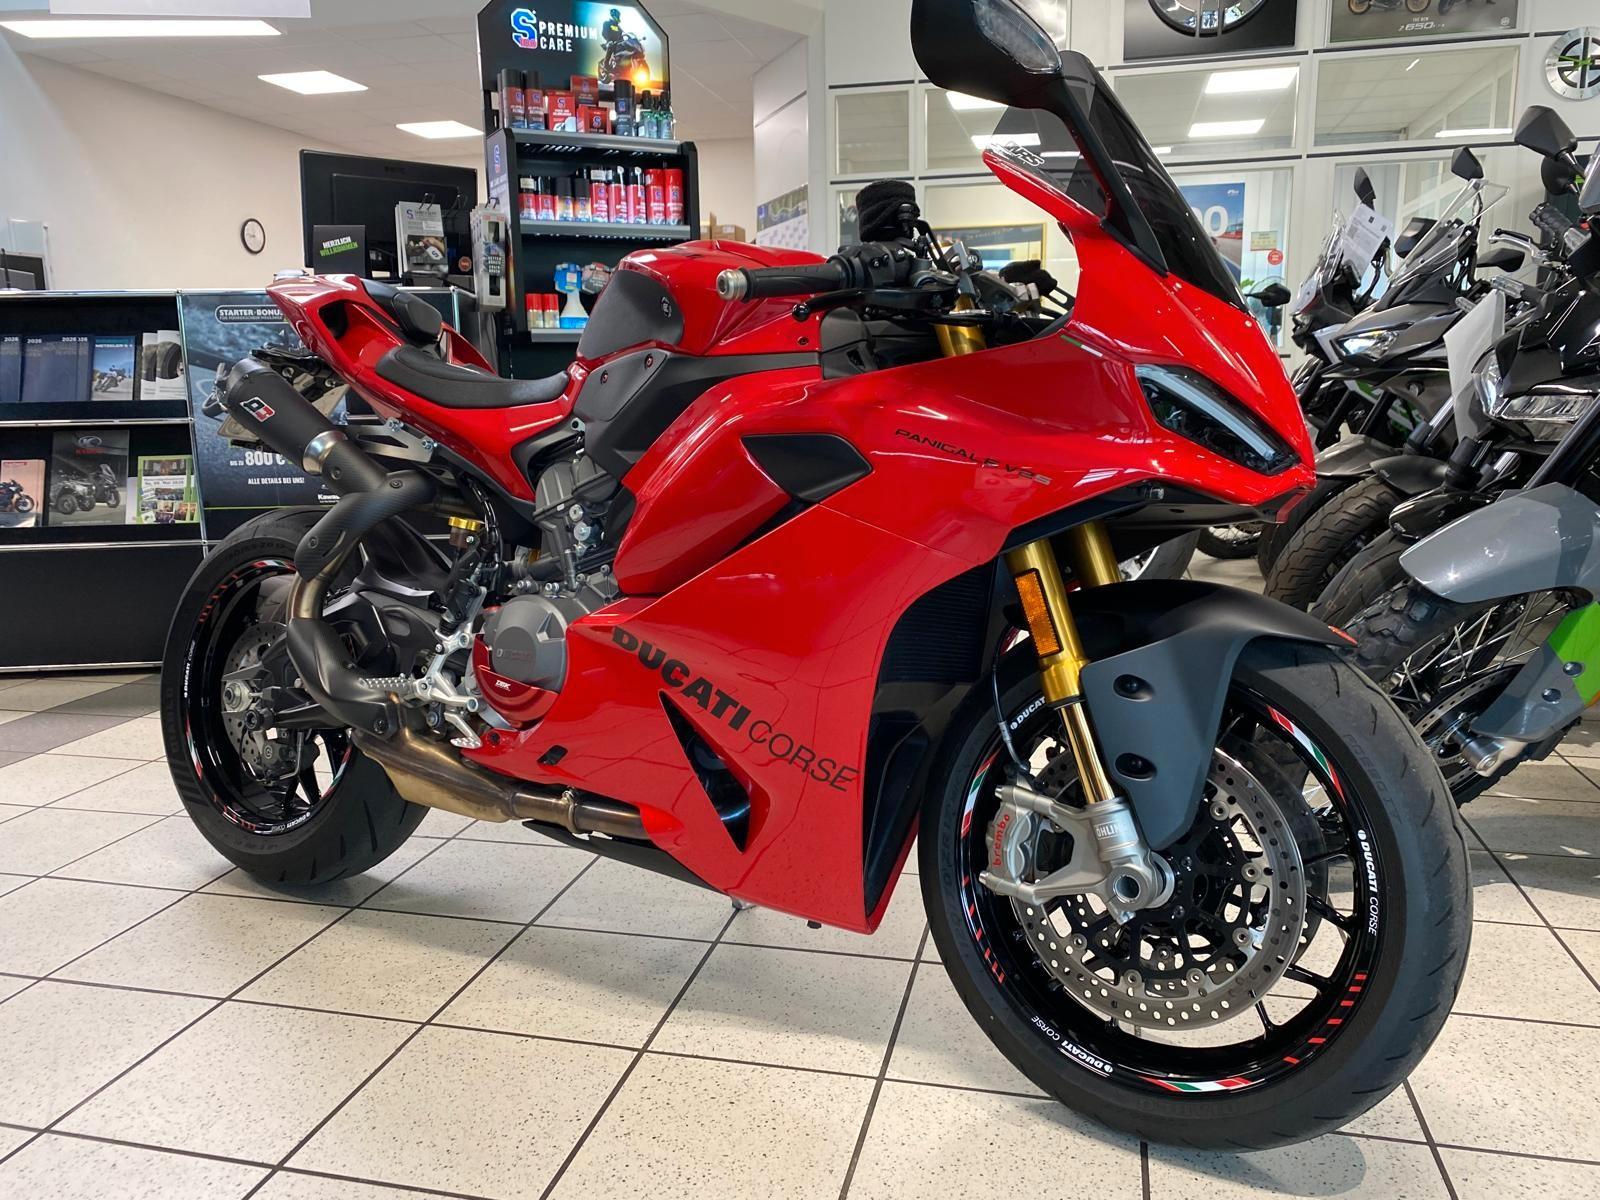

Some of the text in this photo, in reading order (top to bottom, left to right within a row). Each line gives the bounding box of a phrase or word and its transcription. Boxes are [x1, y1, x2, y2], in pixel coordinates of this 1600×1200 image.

[539, 21, 597, 40] PREMIUM
[540, 37, 573, 52] CARE
[219, 309, 284, 317] STARTER-BONU
[245, 451, 273, 466] 800
[261, 477, 282, 485] DETAILS
[282, 477, 292, 485] BEI
[612, 624, 860, 792] DUCATI CORSE
[992, 814, 1009, 867] brembo
[1361, 841, 1379, 937] DUCATI CORSE
[1031, 1015, 1104, 1069] DUCATI CORSE
